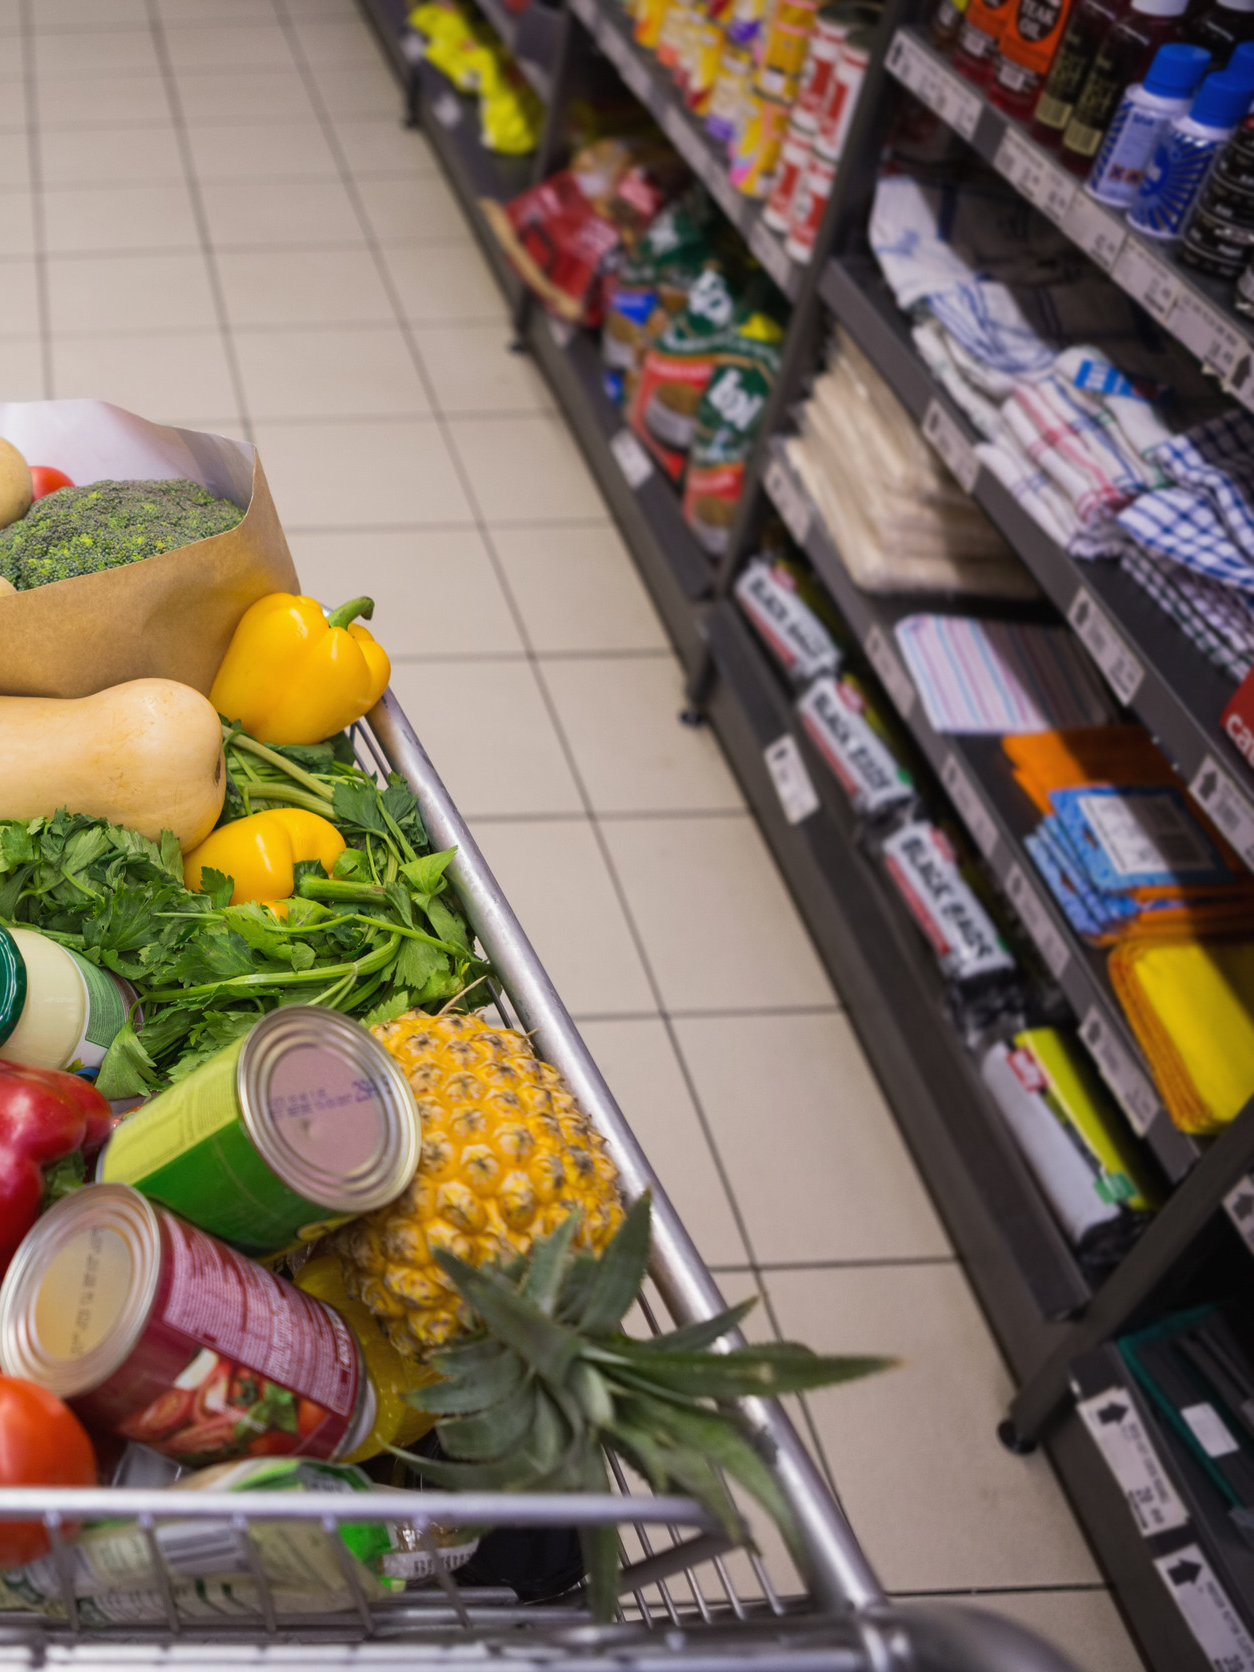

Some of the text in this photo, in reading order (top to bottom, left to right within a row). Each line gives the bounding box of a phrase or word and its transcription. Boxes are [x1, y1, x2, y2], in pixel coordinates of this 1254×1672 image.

[811, 691, 850, 745] BLACK
[901, 836, 994, 958] BLACK BAGS
